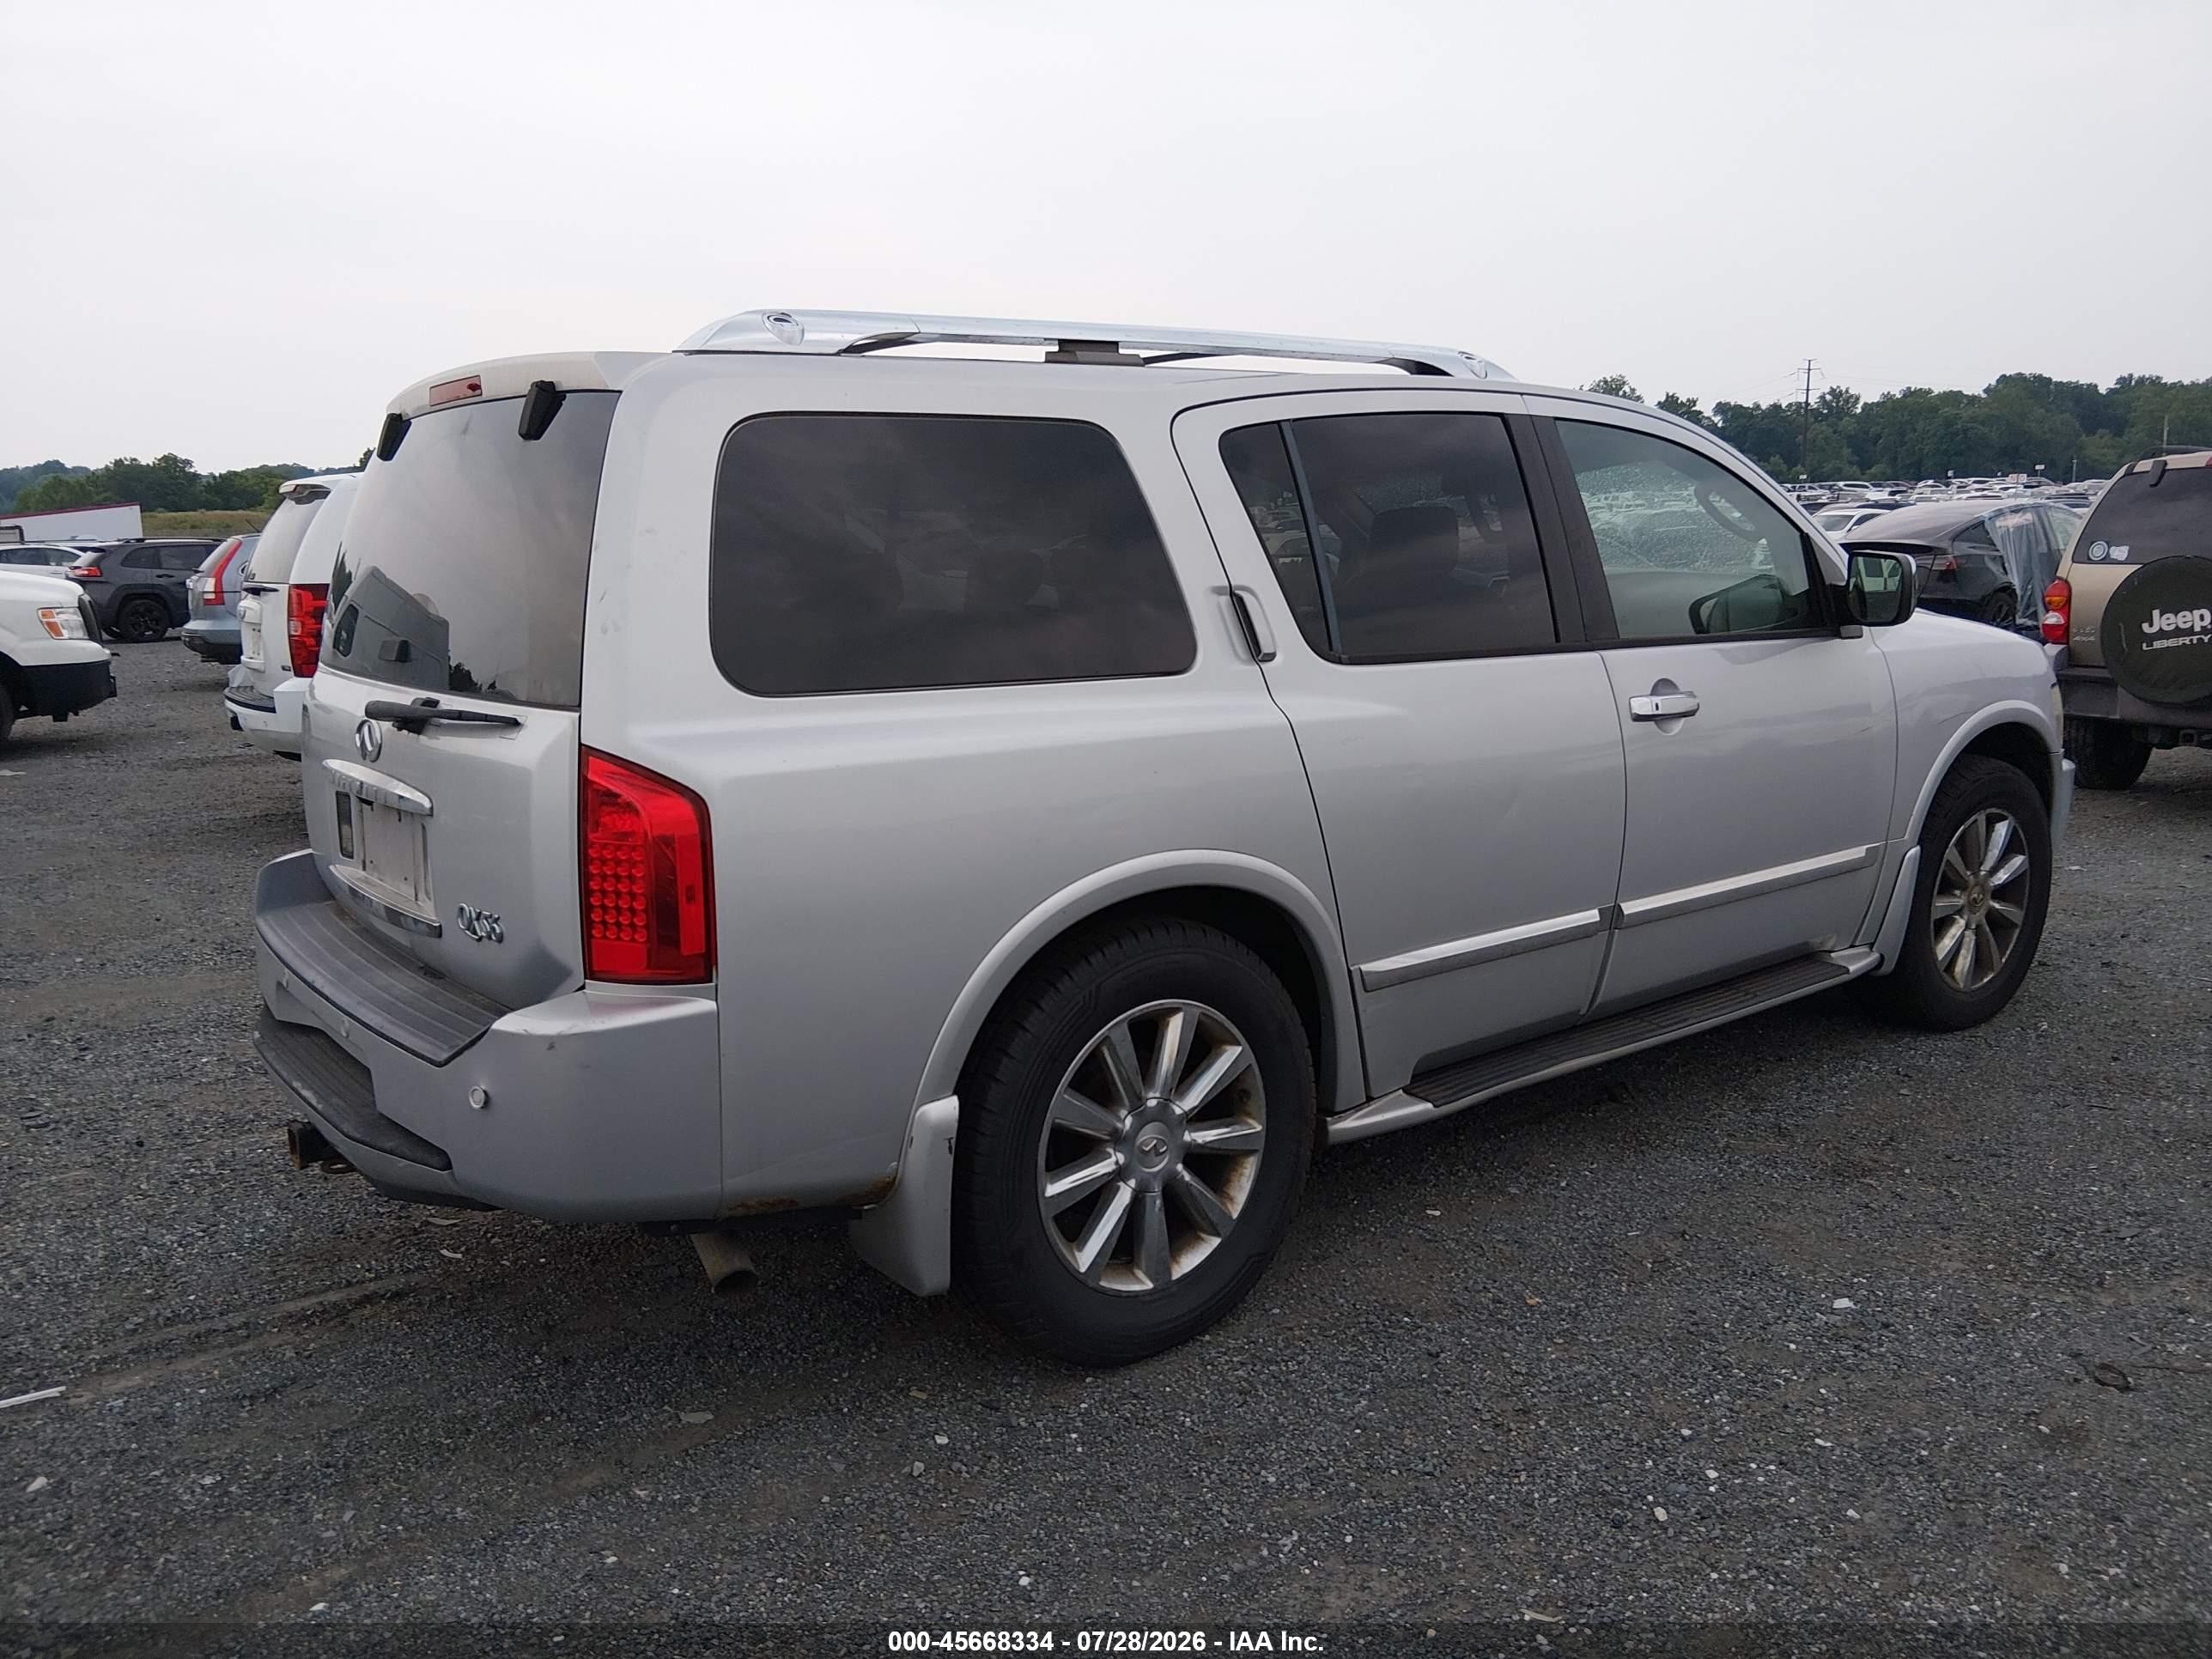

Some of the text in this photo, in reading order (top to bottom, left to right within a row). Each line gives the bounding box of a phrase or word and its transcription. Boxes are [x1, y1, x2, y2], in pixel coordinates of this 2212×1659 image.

[2141, 608, 2211, 634] Jeep
[2142, 634, 2212, 651] LIBERTY
[457, 902, 505, 945] QX56
